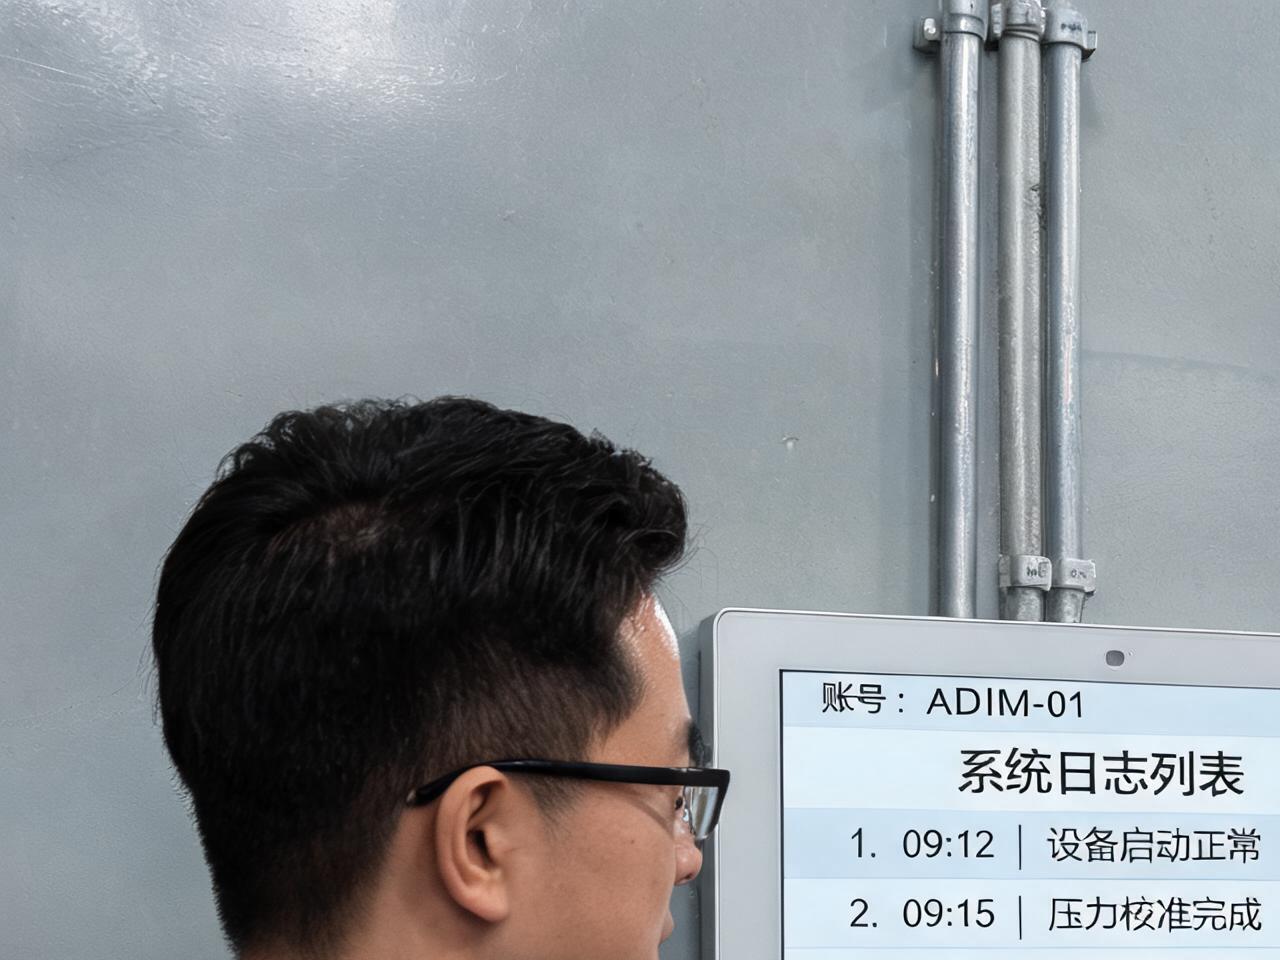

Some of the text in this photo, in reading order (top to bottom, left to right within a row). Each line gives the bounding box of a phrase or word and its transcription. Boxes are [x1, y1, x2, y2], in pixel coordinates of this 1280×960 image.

[926, 688, 1083, 718] ADIM-01
[958, 748, 1245, 797] 系统日志列表
[852, 827, 1261, 863] 1. 09:12 设备启动正常
[850, 896, 1262, 932] 2. 09:15 压力校准完成
